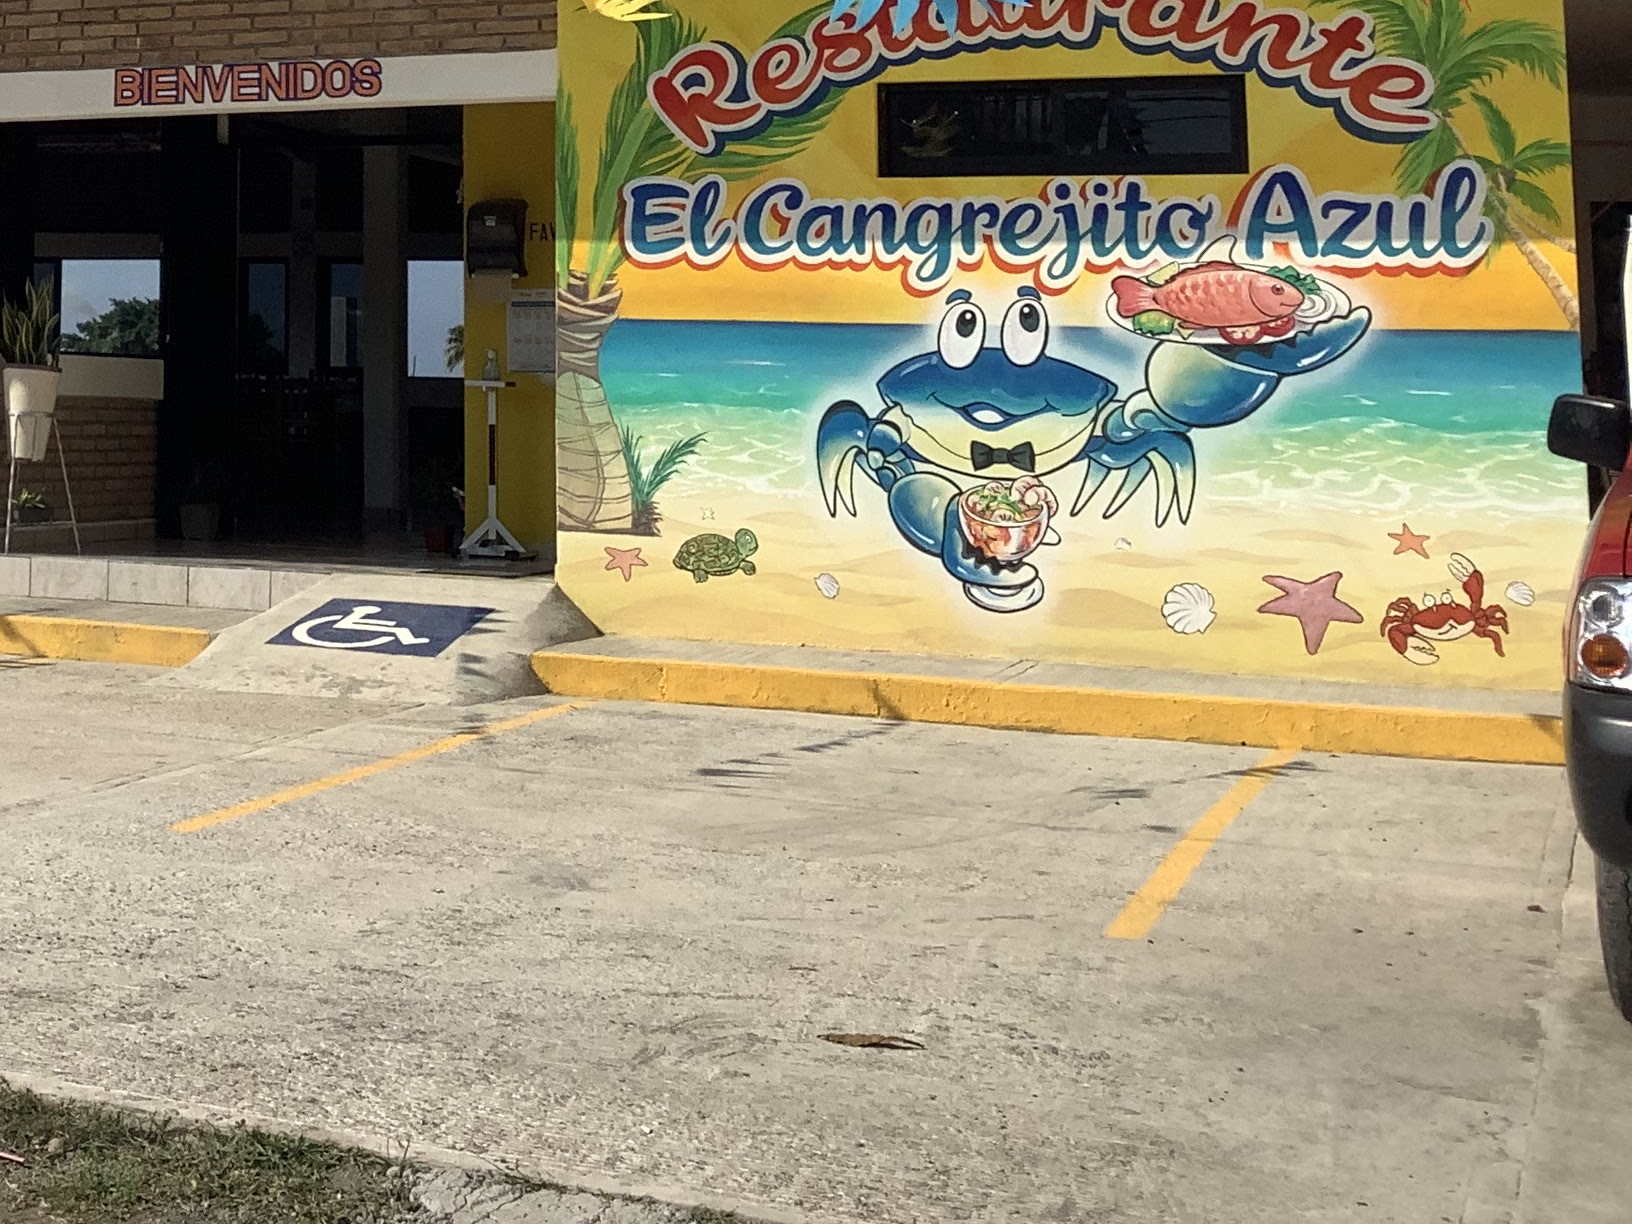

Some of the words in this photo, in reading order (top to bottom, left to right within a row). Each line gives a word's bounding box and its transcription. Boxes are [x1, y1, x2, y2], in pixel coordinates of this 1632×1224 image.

[114, 59, 382, 107] BIENVENIDOS
[627, 178, 735, 260] El
[739, 175, 1216, 285] Cangrejito
[1240, 165, 1489, 262] Azul
